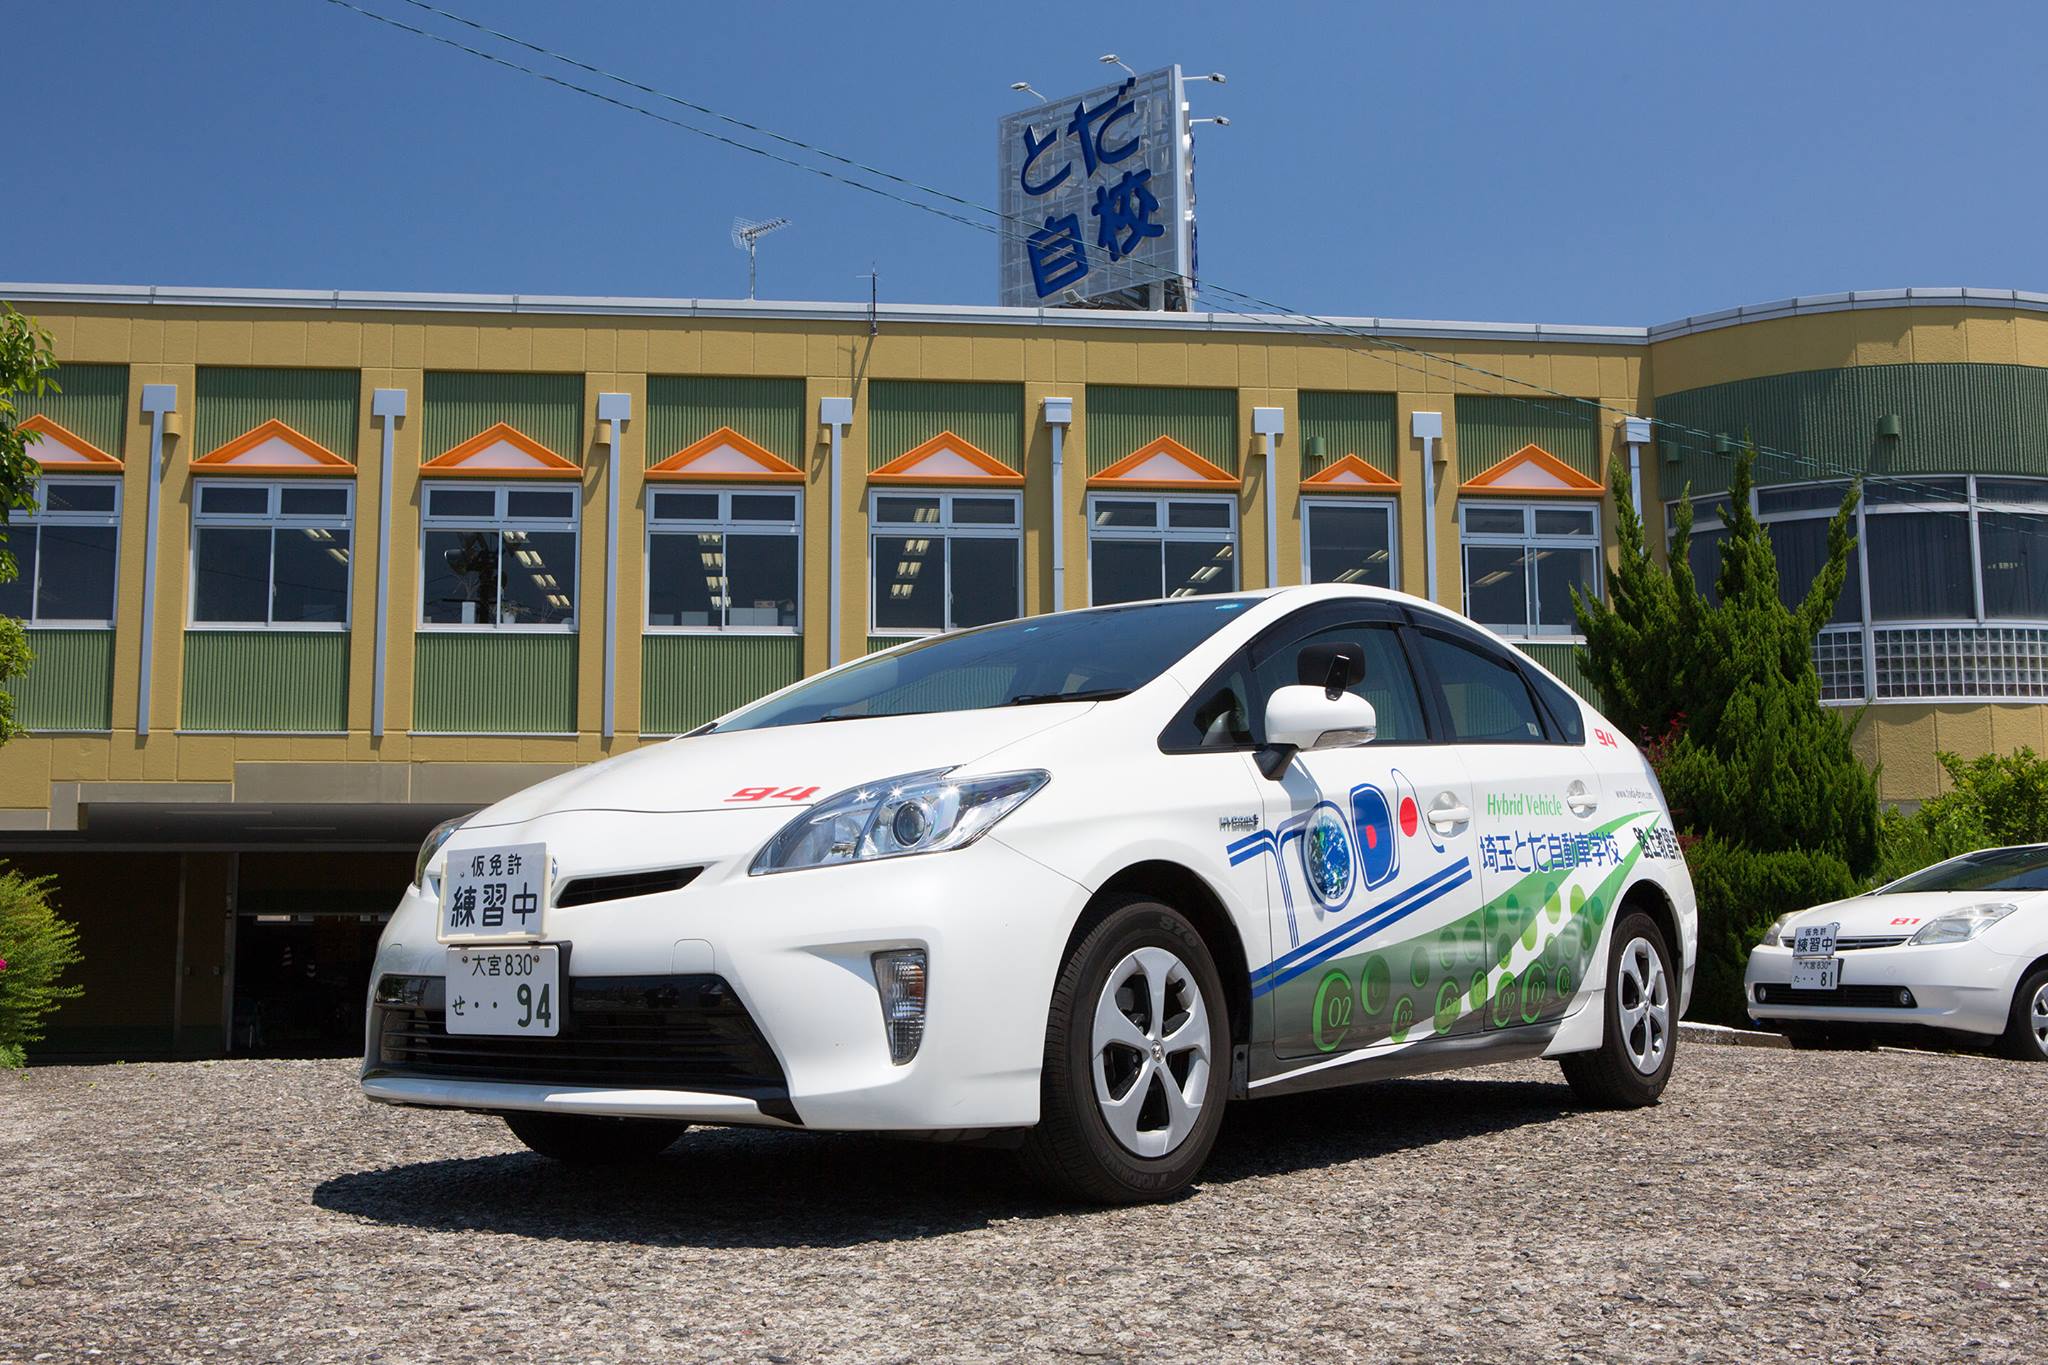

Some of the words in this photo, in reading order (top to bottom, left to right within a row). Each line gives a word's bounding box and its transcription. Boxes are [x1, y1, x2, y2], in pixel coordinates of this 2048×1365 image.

[1020, 76, 1140, 196] とだ
[1026, 168, 1166, 298] 自校
[1594, 727, 1617, 748] 94
[723, 786, 821, 802] 94
[1487, 792, 1523, 822] Hybrid
[1525, 795, 1563, 816] Vehicle
[472, 853, 522, 877] 仮免許
[1479, 830, 1624, 874] 埼玉とだ自動車学校
[451, 882, 538, 927] 練習中
[1797, 937, 1833, 952] 練習中
[1805, 927, 1827, 936] 仮免許
